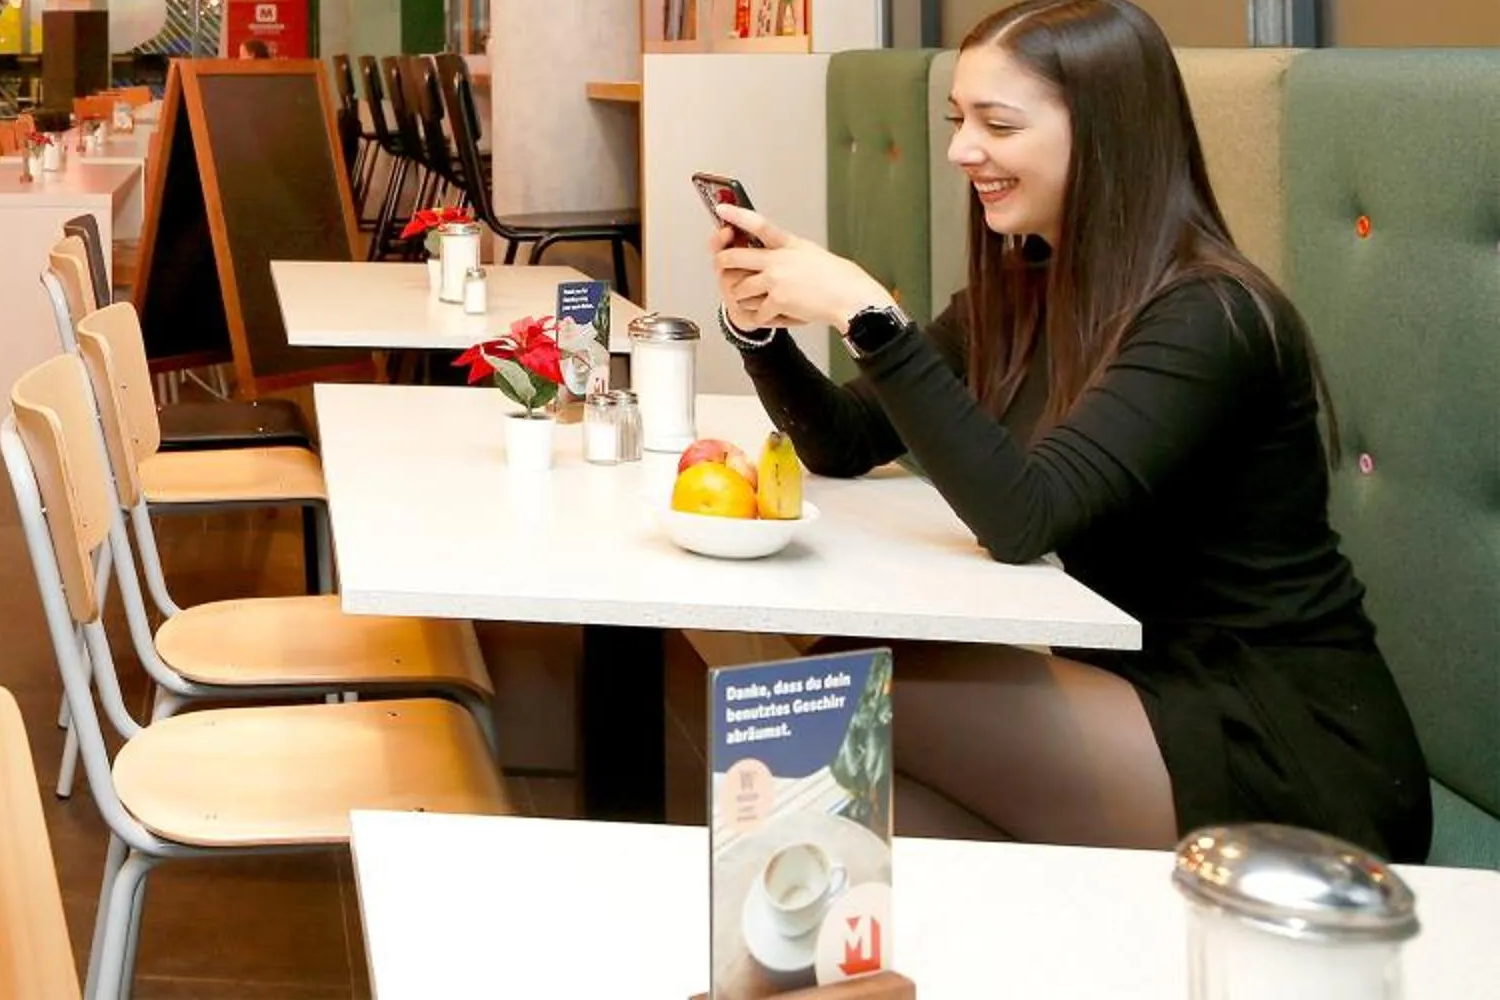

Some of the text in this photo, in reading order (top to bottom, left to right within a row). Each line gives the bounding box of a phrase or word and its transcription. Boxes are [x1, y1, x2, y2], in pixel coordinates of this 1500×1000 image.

[726, 672, 851, 701] Danke, dass du dein
[726, 694, 846, 723] benutztes Geschirr
[726, 722, 792, 745] abräumst.
